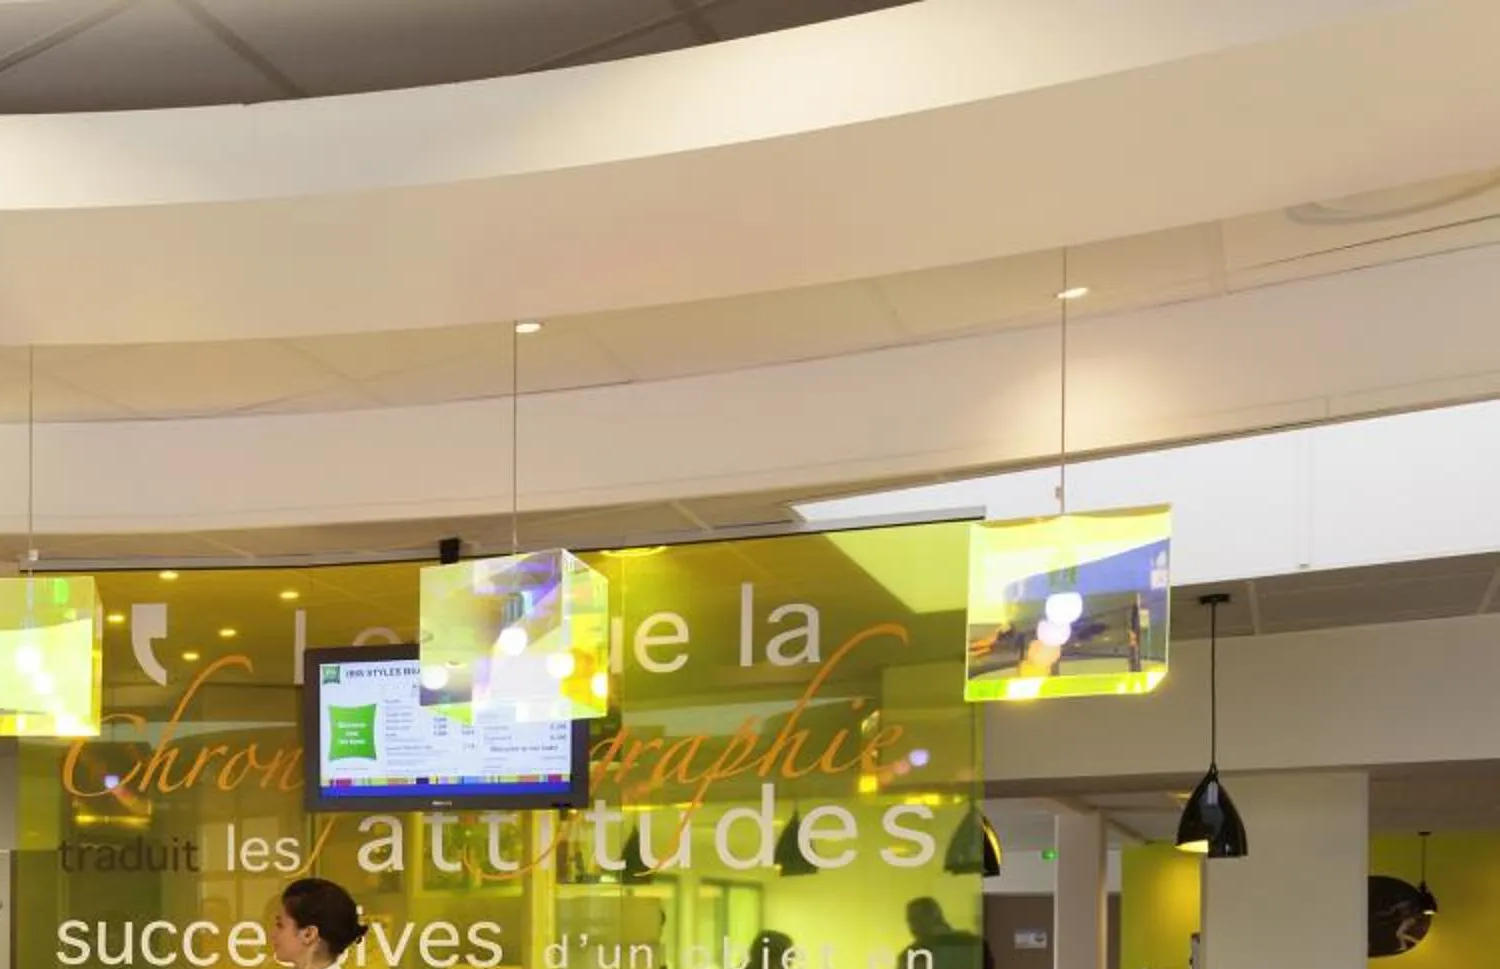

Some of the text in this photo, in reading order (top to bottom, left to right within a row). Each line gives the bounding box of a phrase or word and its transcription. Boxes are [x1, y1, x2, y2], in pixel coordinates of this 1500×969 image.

[739, 581, 821, 668] la
[58, 783, 936, 873] traduit les attitudes
[56, 904, 504, 969] succeives
